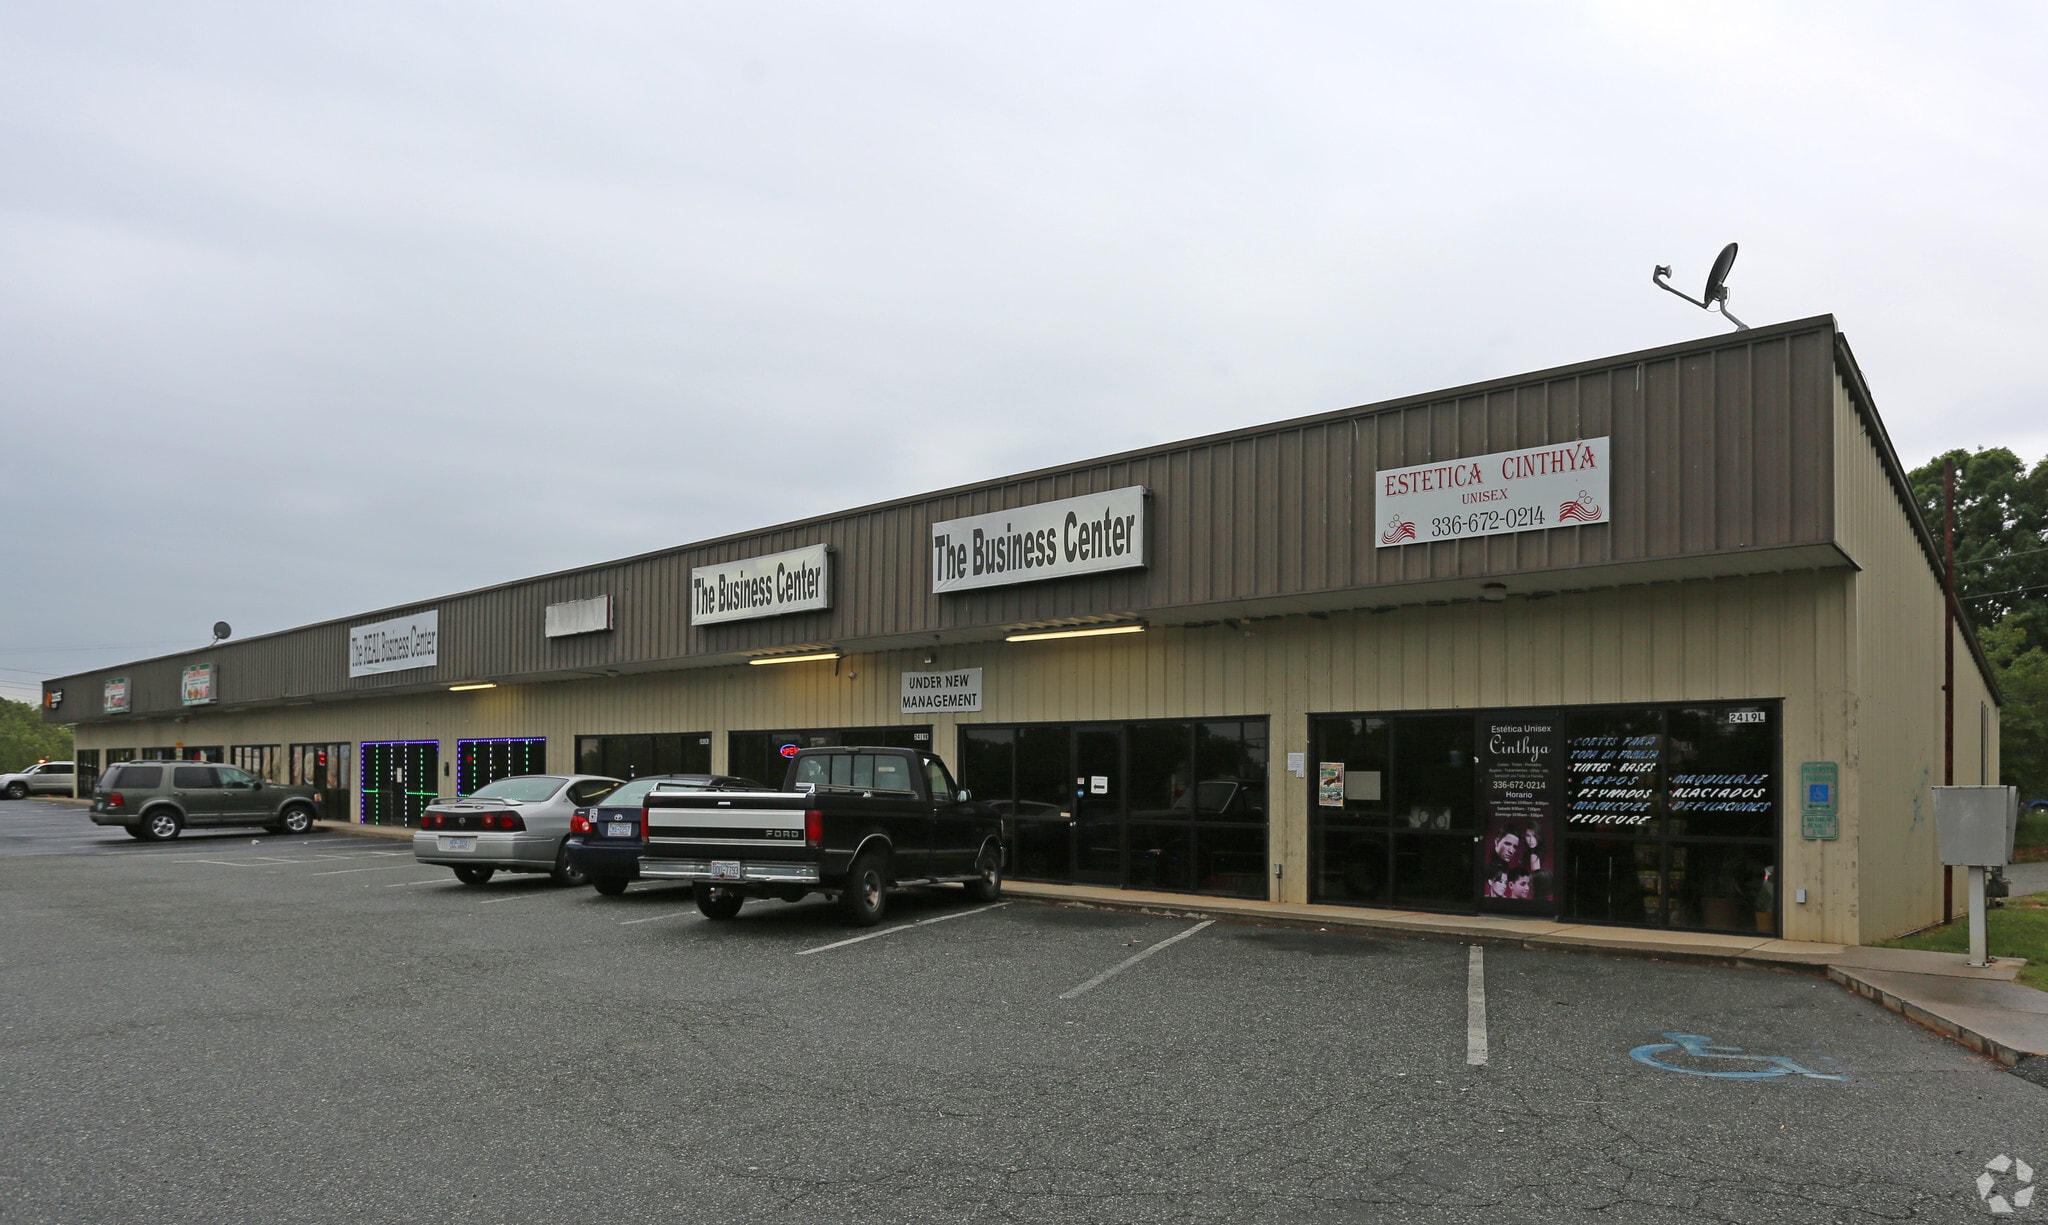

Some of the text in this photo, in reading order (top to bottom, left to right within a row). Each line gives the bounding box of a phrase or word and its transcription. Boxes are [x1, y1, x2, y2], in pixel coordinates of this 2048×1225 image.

[1385, 442, 1598, 497] ESTETICA CINTHYA
[1462, 488, 1509, 505] UNISEX
[1431, 505, 1546, 538] 336-672-0214
[934, 506, 1135, 582] The Business Center
[693, 560, 821, 615] The Business Center
[351, 625, 436, 667] The REAL Business Center
[909, 674, 970, 689] UNDER NEW
[902, 693, 977, 708] MANAGEMENT
[1730, 712, 1764, 722] 2419L
[1524, 724, 1552, 732] Unisex
[1573, 736, 1656, 746] CORTES PARA
[782, 746, 799, 756] OPEN
[1489, 734, 1552, 762] Cinthya
[1570, 750, 1660, 760] TODA LA FAMILIA
[1572, 762, 1657, 772] TINTES BASES
[1492, 780, 1546, 790] 336-672-0214
[1581, 776, 1640, 786] RAYOS
[1672, 774, 1769, 786] MAQUILLAJE
[1672, 788, 1766, 798] ALACIADOS
[1572, 801, 1652, 812] MANICURE
[1672, 801, 1772, 812] DEPILACIONES
[1570, 814, 1652, 825] PEDICURE
[766, 829, 800, 838] FORD
